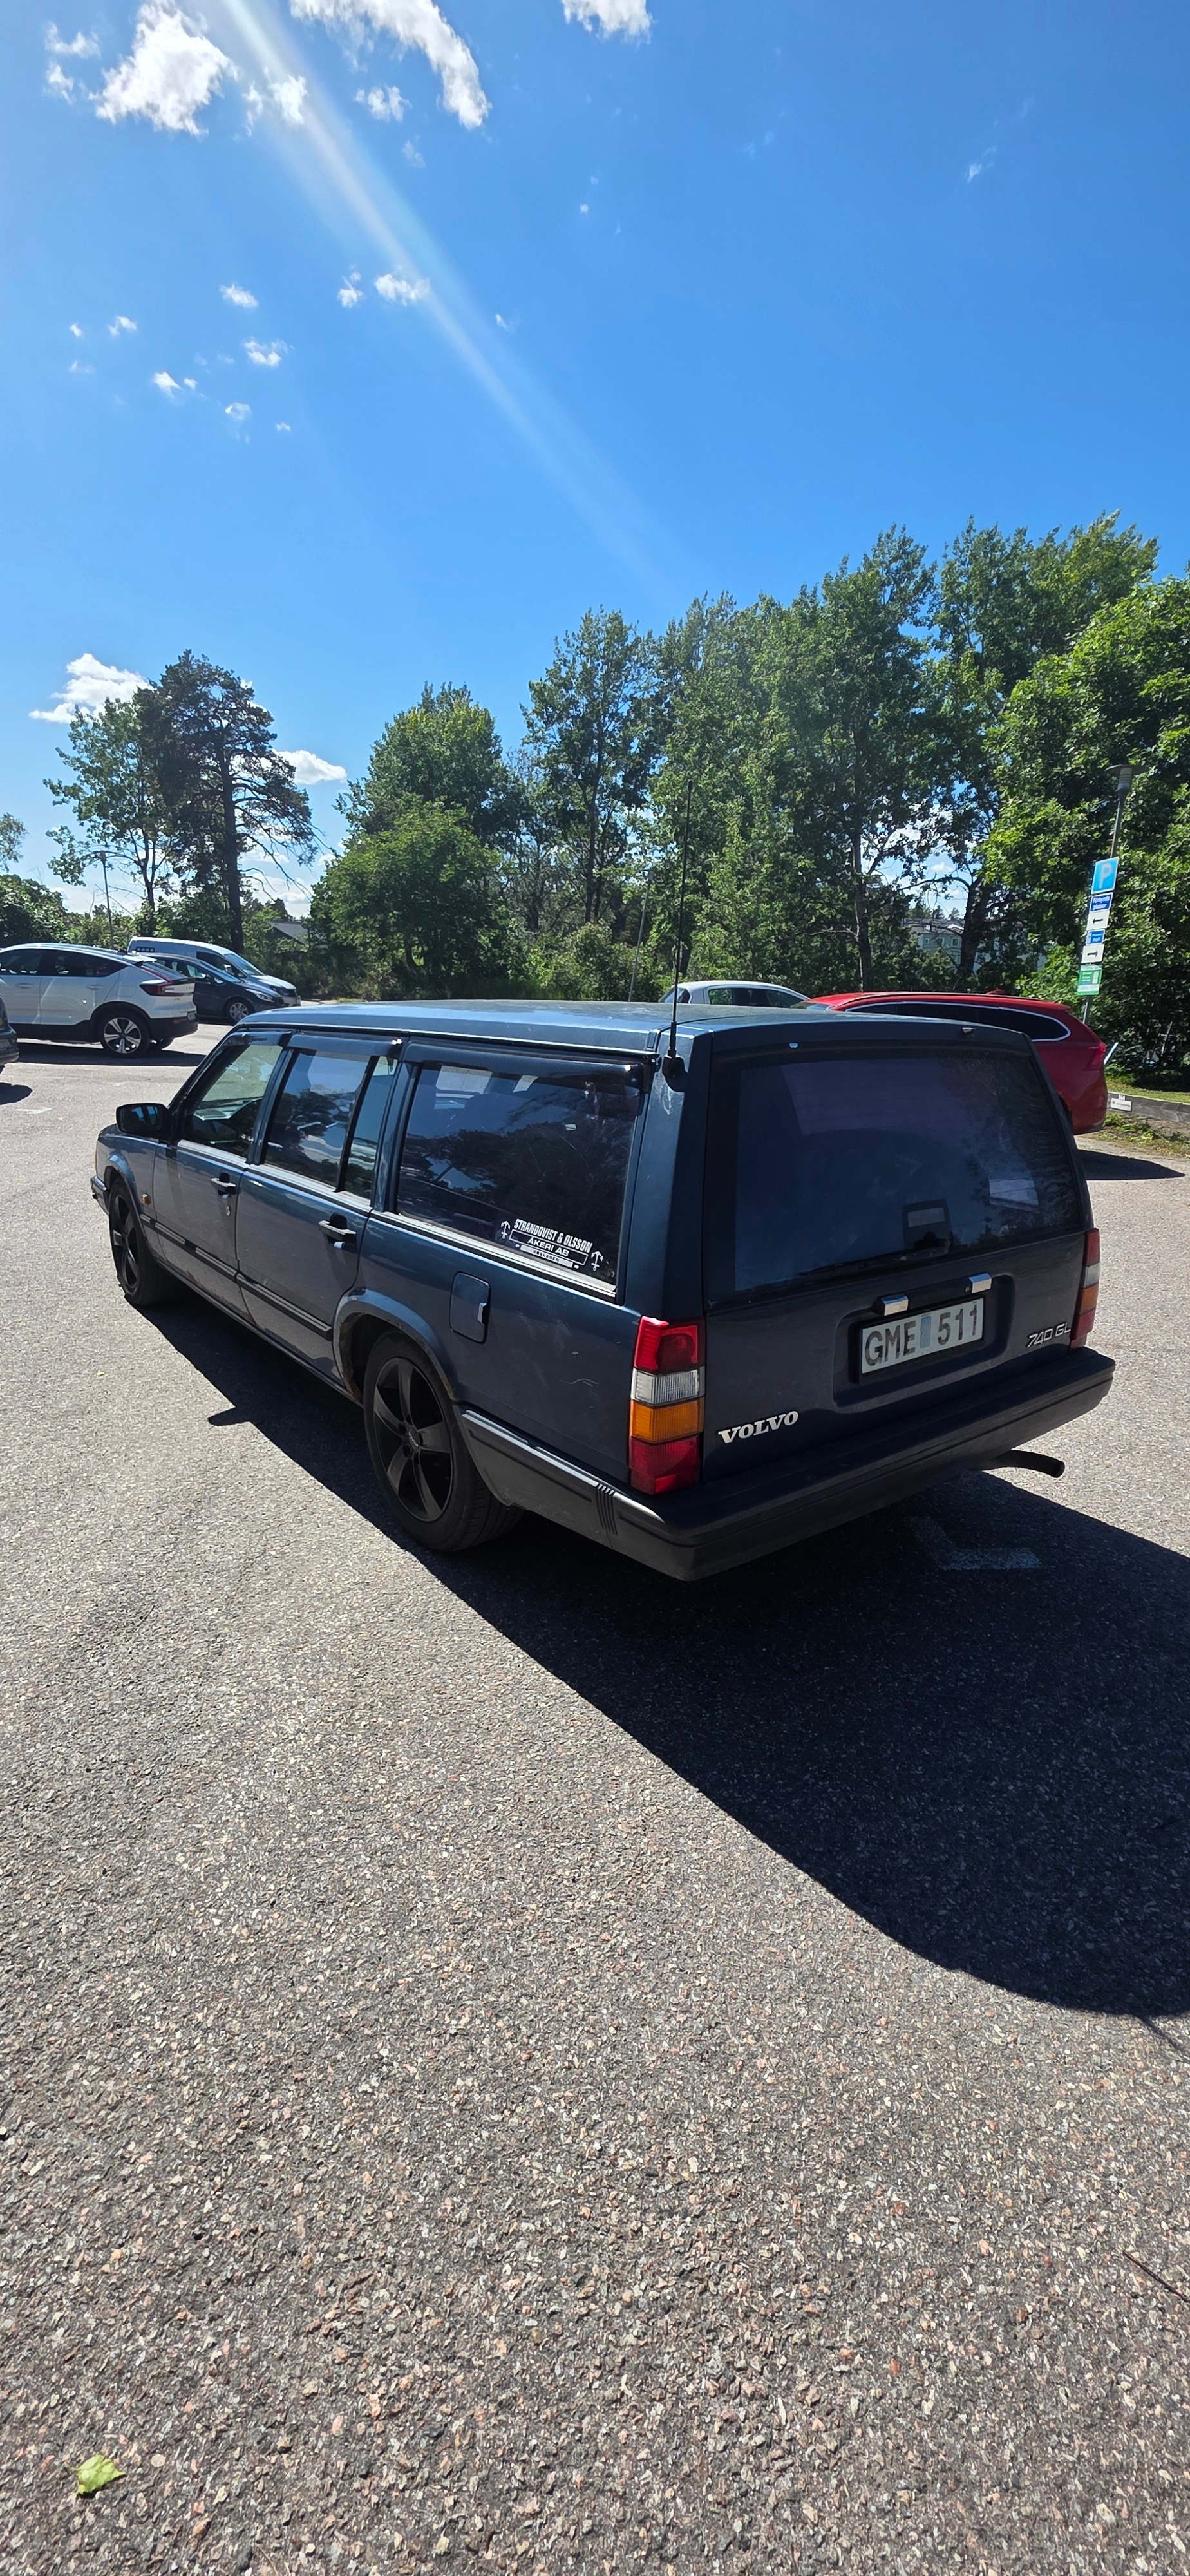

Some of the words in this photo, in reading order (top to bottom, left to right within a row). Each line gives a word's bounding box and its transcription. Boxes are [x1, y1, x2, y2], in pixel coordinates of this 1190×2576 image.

[1098, 862, 1112, 889] P
[514, 1218, 558, 1241] STRANDQVIST
[557, 1233, 564, 1243] &
[563, 1235, 593, 1253] OLSSON
[527, 1236, 554, 1251] ÅKERI
[555, 1247, 570, 1256] AB
[865, 1320, 916, 1366] GME
[938, 1304, 978, 1345] 511
[1027, 1328, 1053, 1347] 740
[1055, 1322, 1071, 1337] GL
[718, 1410, 798, 1444] VOLVO
